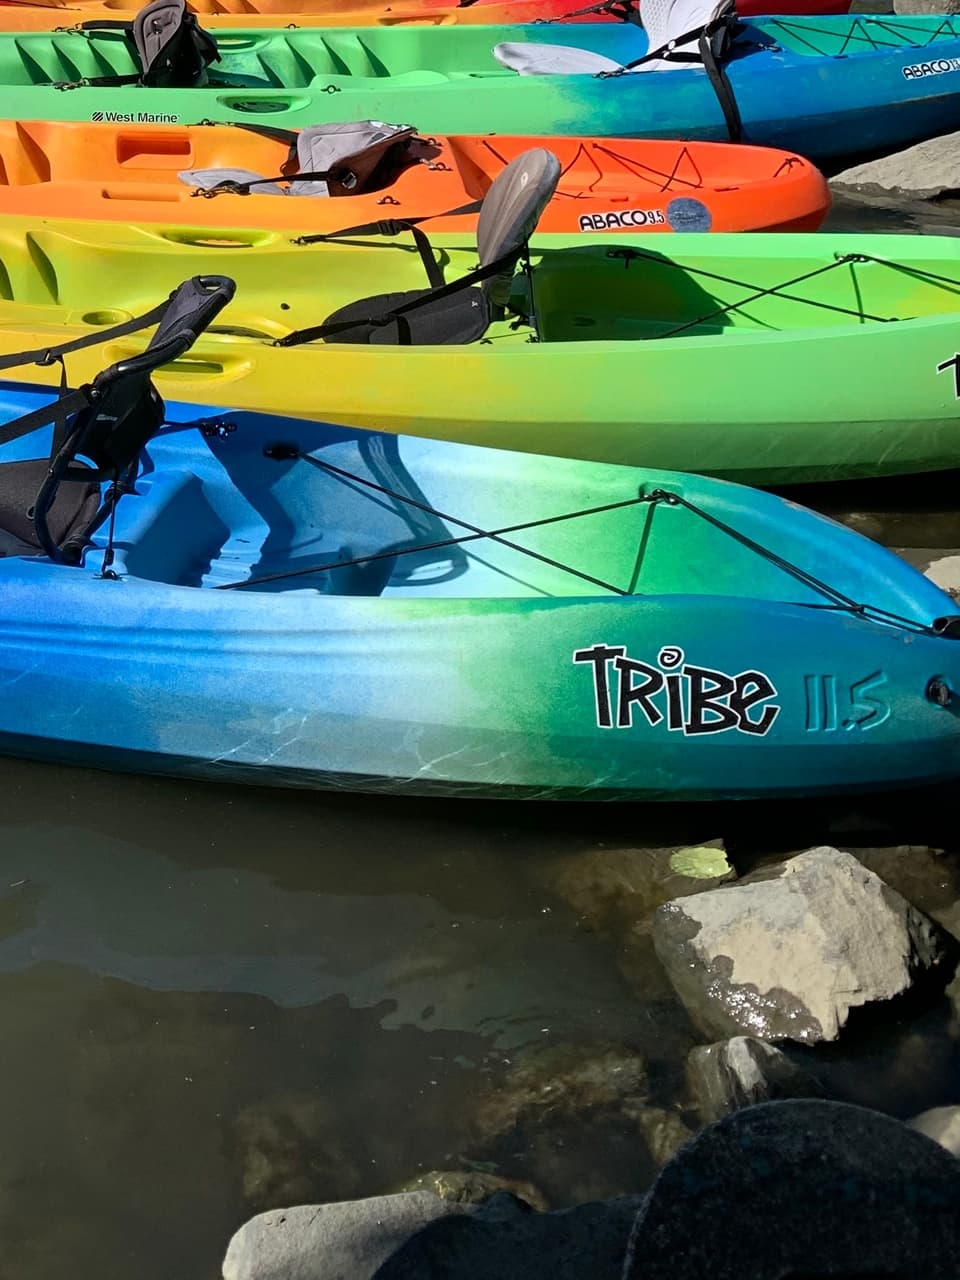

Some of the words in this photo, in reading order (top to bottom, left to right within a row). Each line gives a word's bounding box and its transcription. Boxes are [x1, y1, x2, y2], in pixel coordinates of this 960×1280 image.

[105, 111, 134, 122] West
[137, 112, 179, 123] Marine
[803, 668, 892, 732] 11.5
